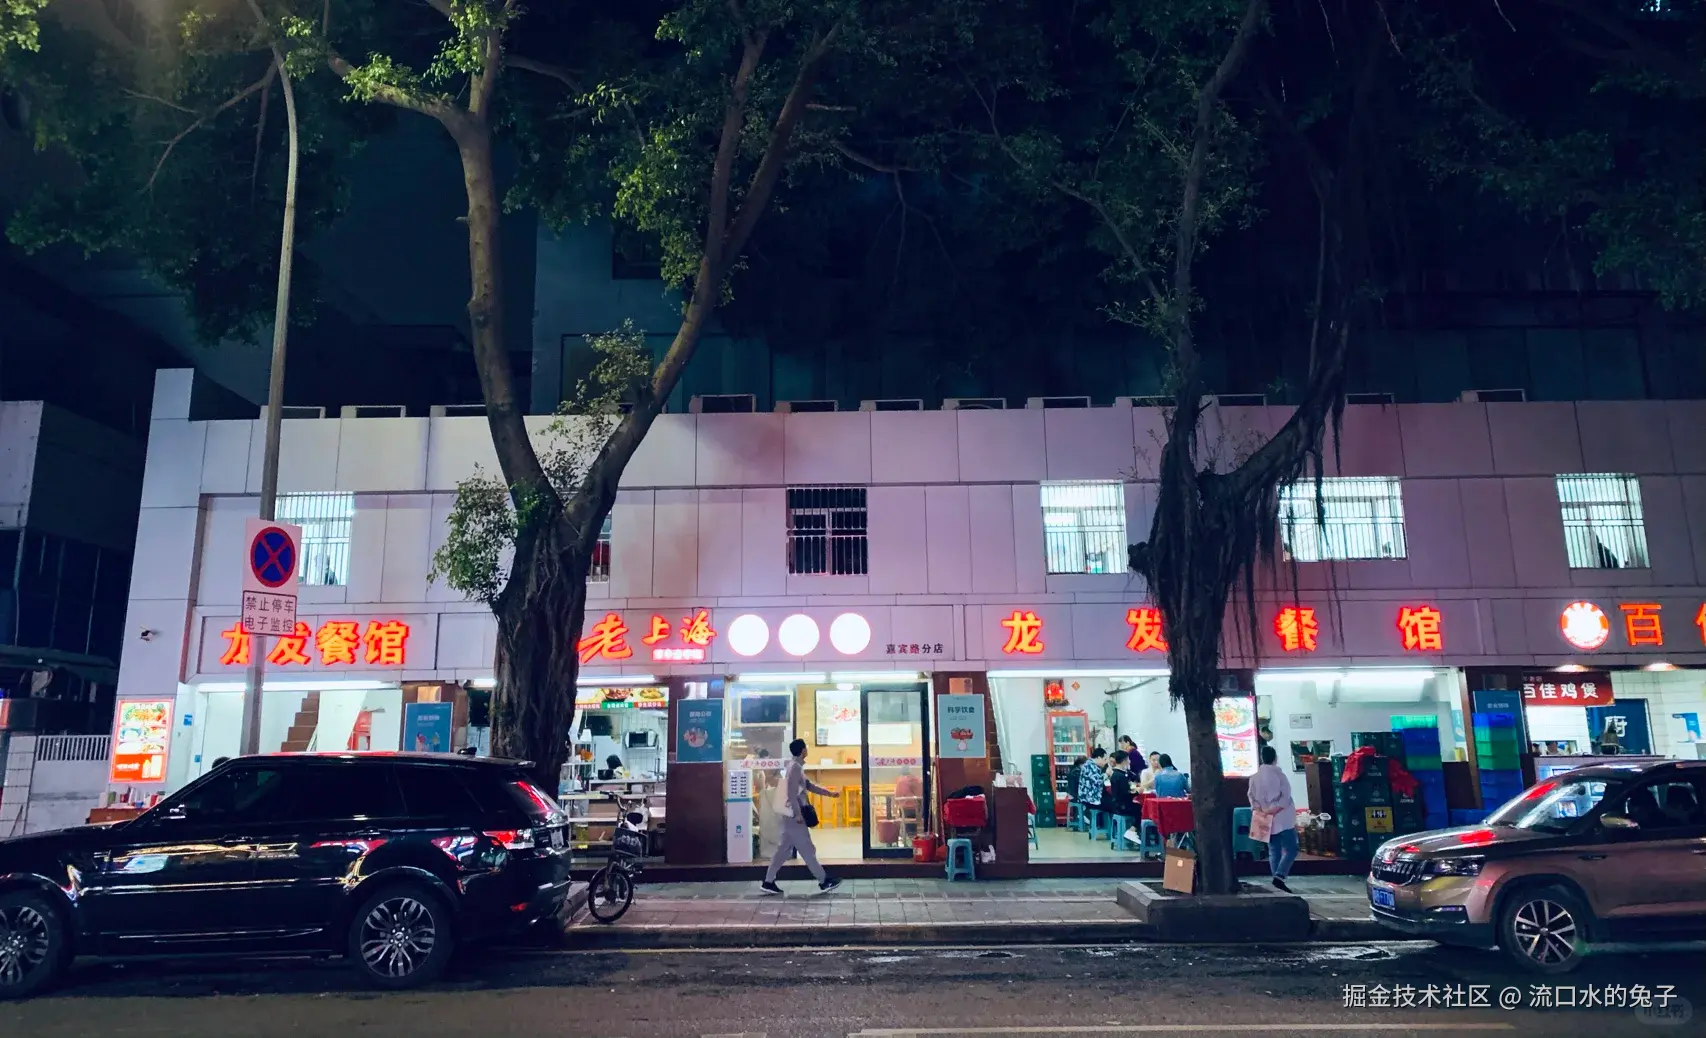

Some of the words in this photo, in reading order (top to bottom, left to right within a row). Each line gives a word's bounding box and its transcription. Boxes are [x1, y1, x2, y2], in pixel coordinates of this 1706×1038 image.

[245, 596, 294, 614] 禁止停车
[244, 616, 294, 633] 电子监控
[886, 643, 943, 655] 嘉宾路分店
